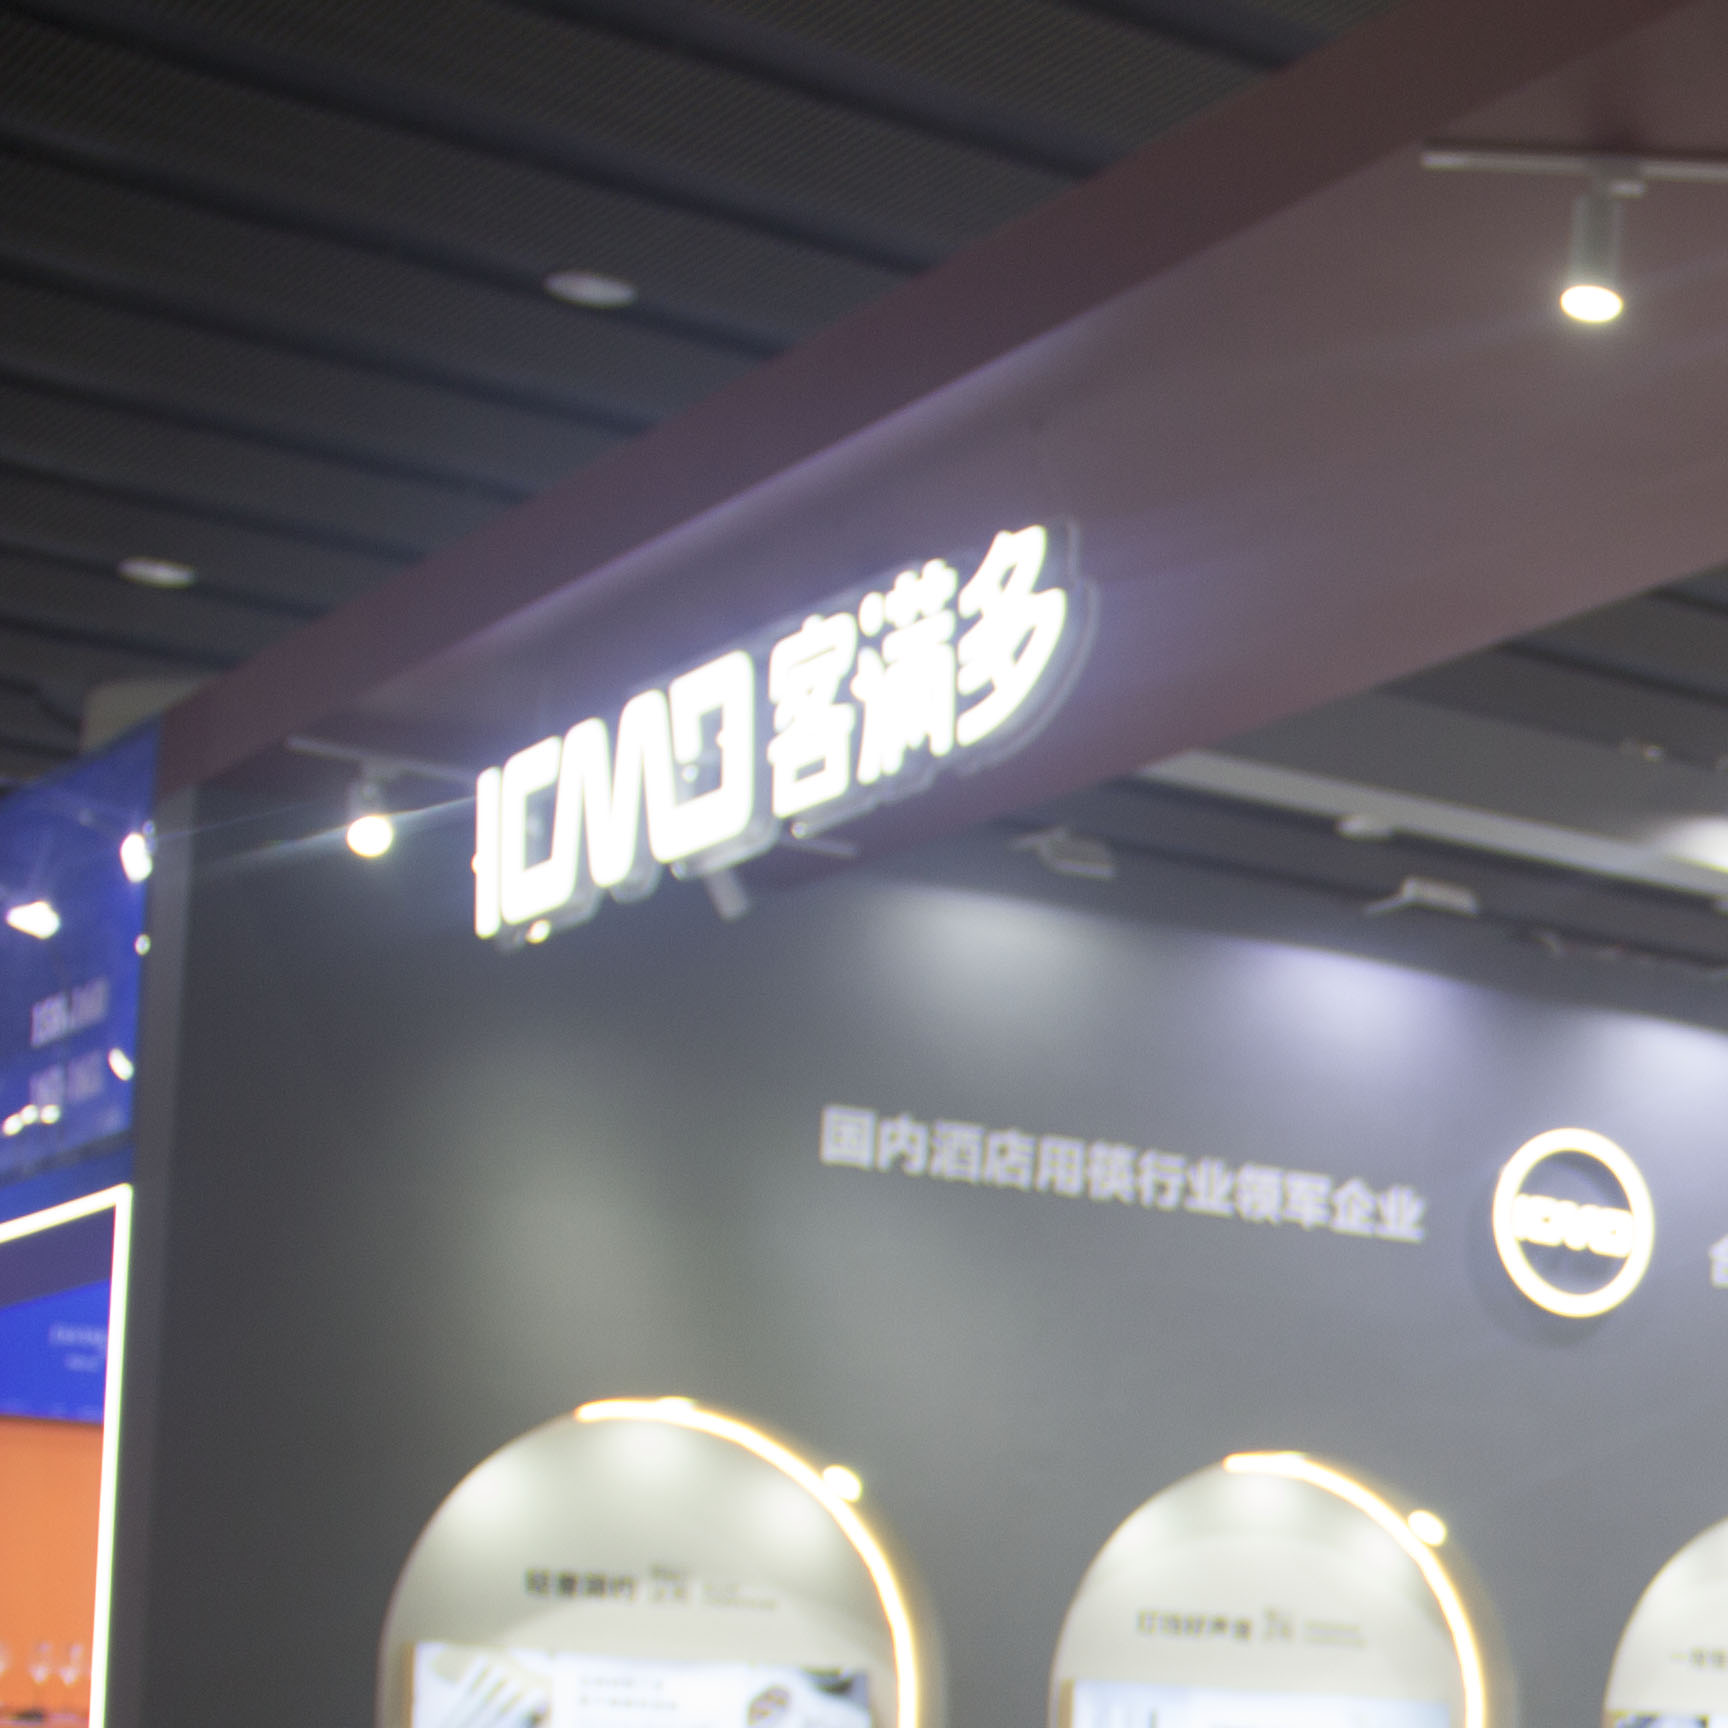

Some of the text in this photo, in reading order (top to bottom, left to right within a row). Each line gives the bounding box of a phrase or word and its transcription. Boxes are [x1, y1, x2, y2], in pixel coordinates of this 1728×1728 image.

[767, 525, 1067, 818] 客满多
[820, 1105, 1426, 1242] 国内酒店用筷行业领军企业
